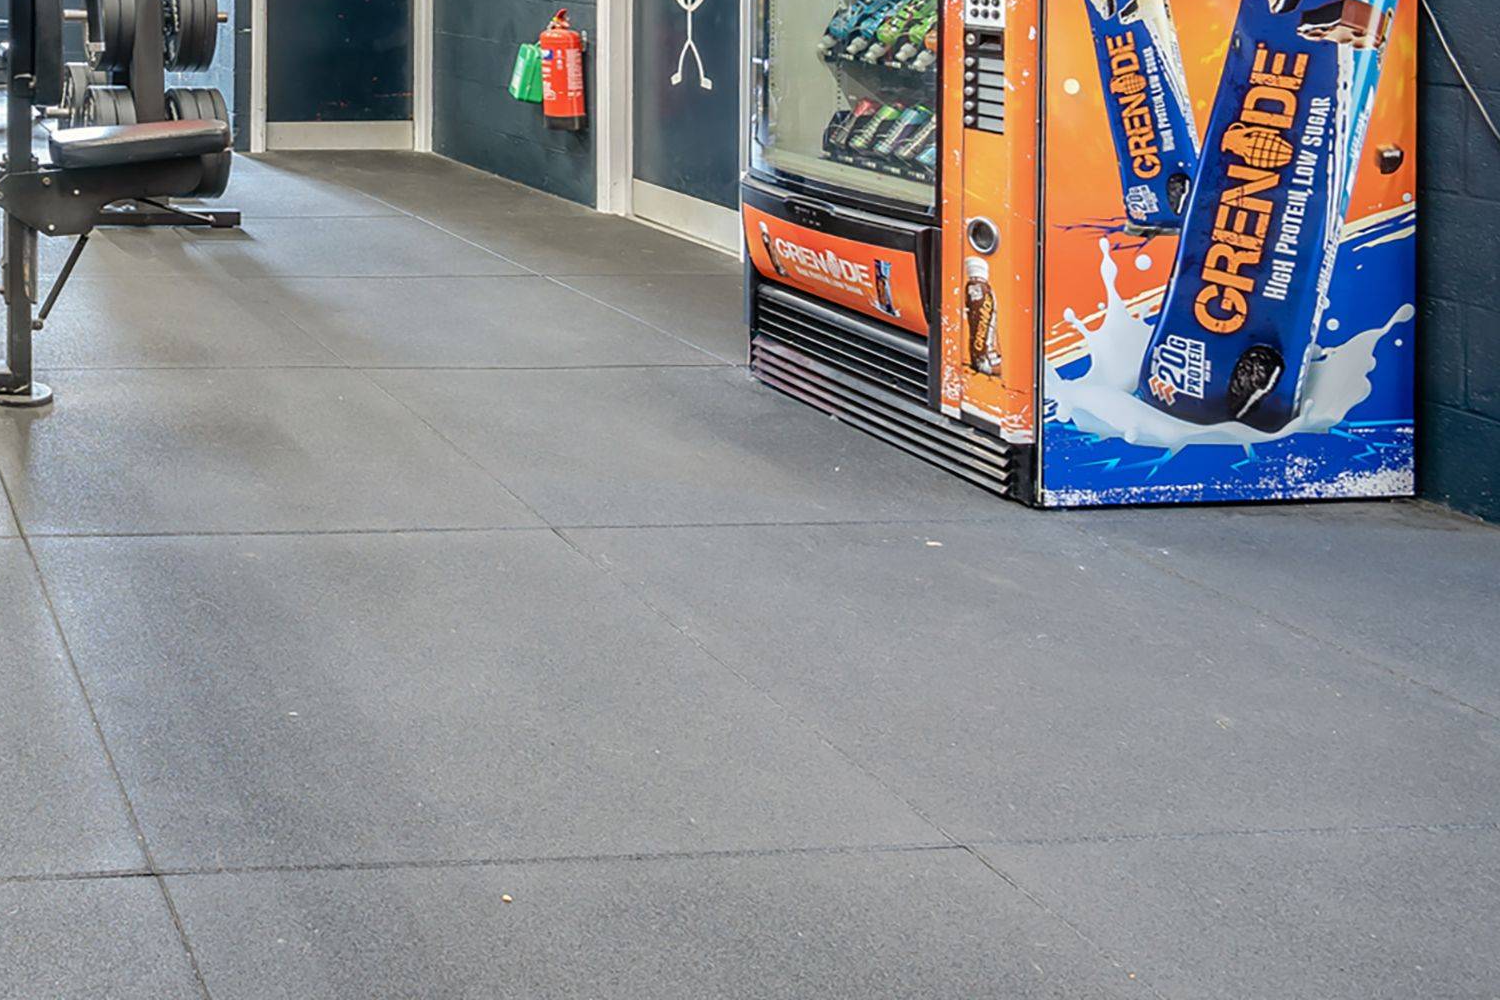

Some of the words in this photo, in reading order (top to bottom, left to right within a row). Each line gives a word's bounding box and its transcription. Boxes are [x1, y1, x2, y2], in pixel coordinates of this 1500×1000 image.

[1104, 30, 1162, 179] GRENADE
[1303, 95, 1332, 148] SUGAR
[1193, 47, 1310, 335] GRENADE
[1291, 151, 1319, 187] LOW
[774, 237, 874, 288] GRENADE
[1262, 258, 1297, 301] HIGH
[1158, 337, 1188, 391] 20G
[1187, 341, 1203, 396] PROTEIN
